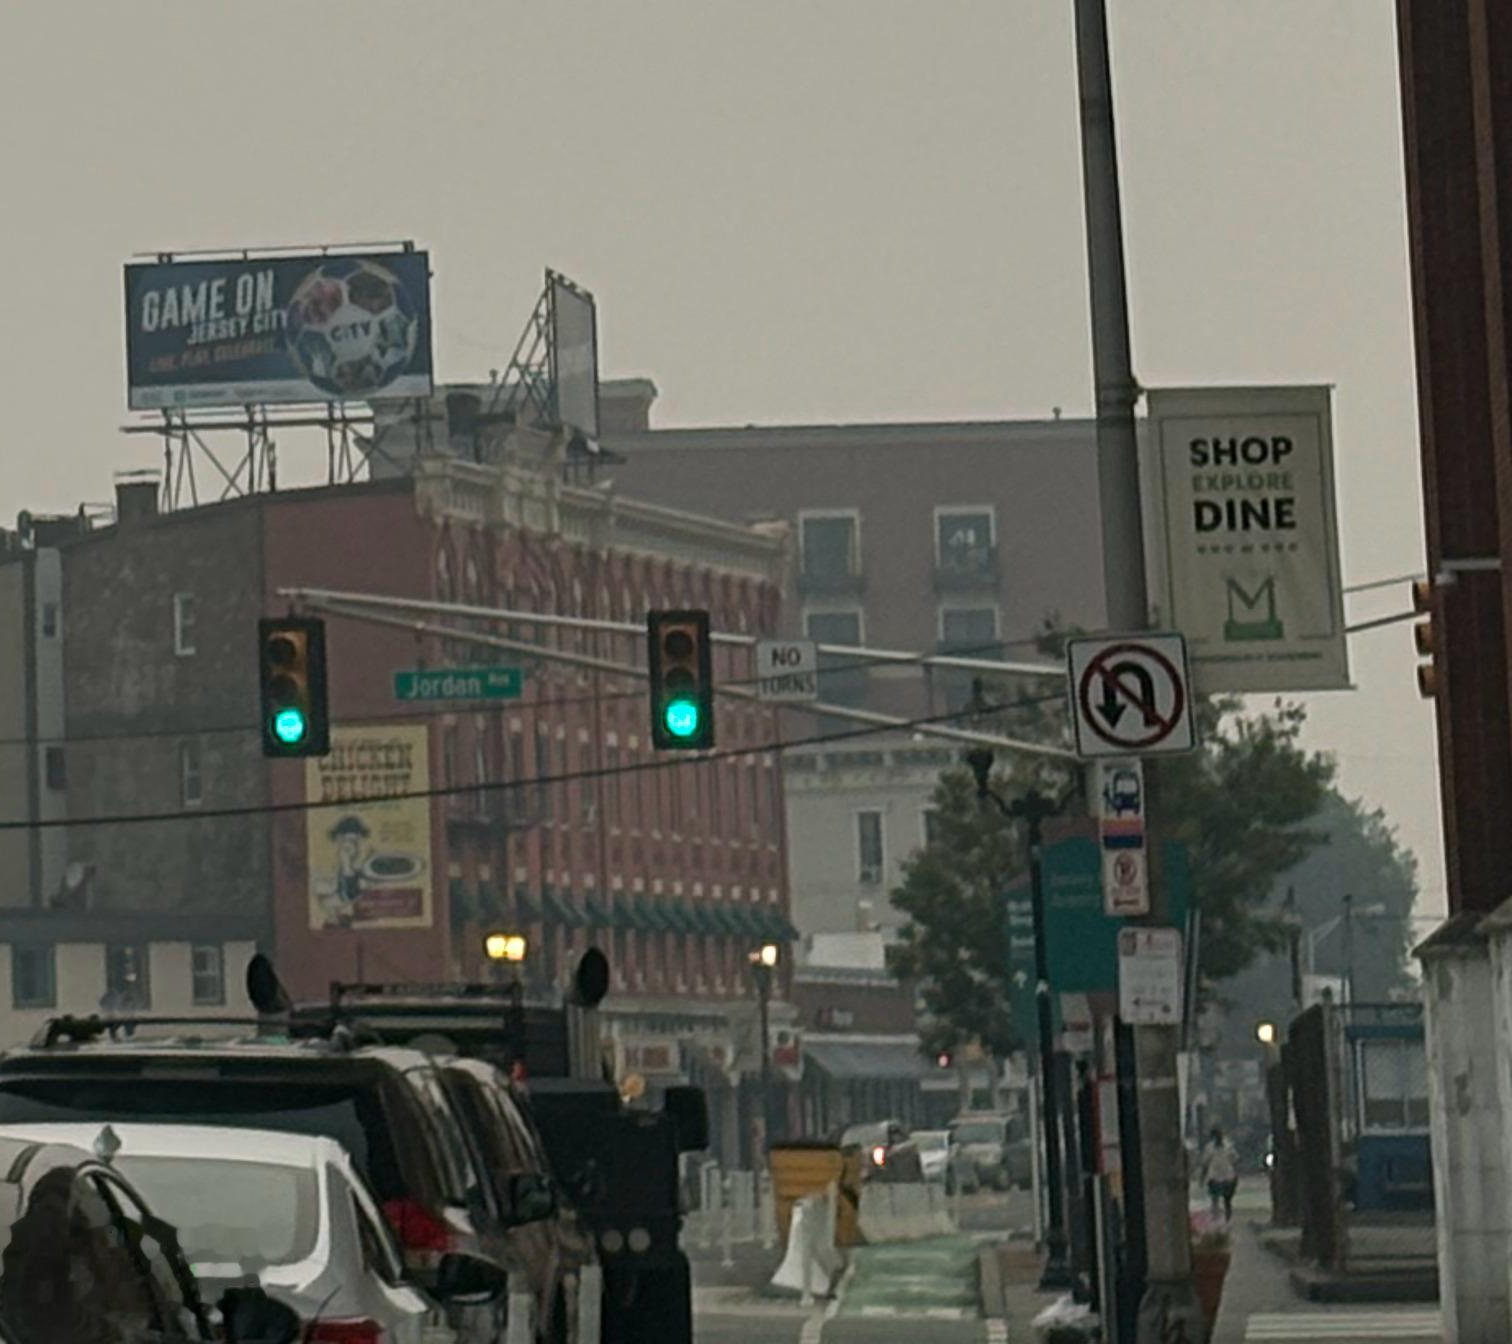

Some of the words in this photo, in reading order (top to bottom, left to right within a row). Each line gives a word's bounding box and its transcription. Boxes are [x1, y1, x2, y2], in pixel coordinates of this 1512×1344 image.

[142, 277, 227, 332] GAME
[235, 269, 275, 316] ON
[186, 316, 249, 345] JERSEY
[252, 309, 289, 334] CITY
[1189, 435, 1293, 467] SHOP
[1191, 471, 1294, 493] EXPLORE
[1193, 496, 1297, 533] DINE
[771, 646, 802, 667] NO
[406, 673, 482, 699] Jordan
[761, 673, 815, 694] TURNS
